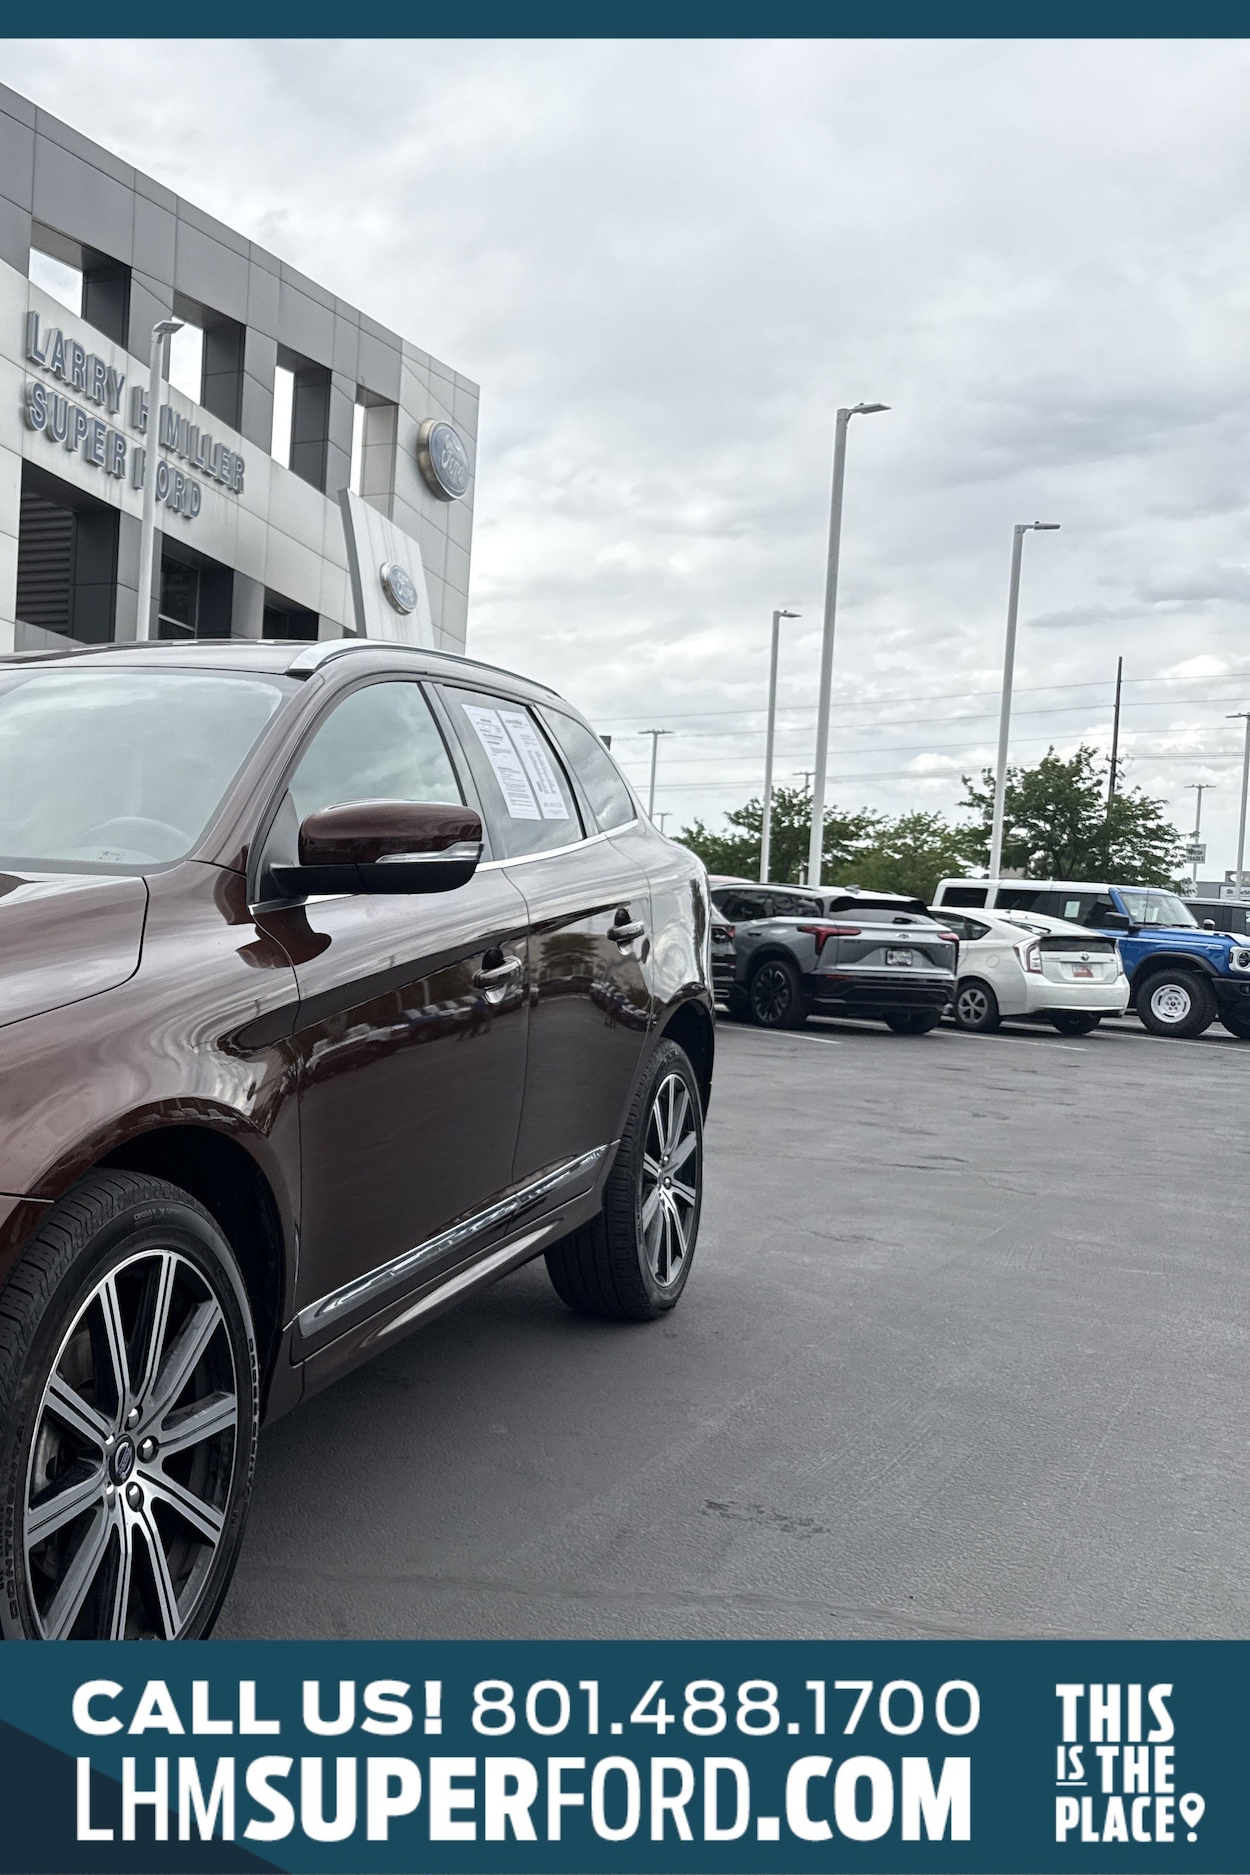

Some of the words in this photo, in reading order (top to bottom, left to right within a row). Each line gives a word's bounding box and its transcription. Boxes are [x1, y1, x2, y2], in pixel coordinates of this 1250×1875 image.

[25, 382, 127, 479] SUPER
[26, 311, 126, 414] LARRY
[159, 404, 245, 494] MILLER
[441, 433, 464, 485] Ford
